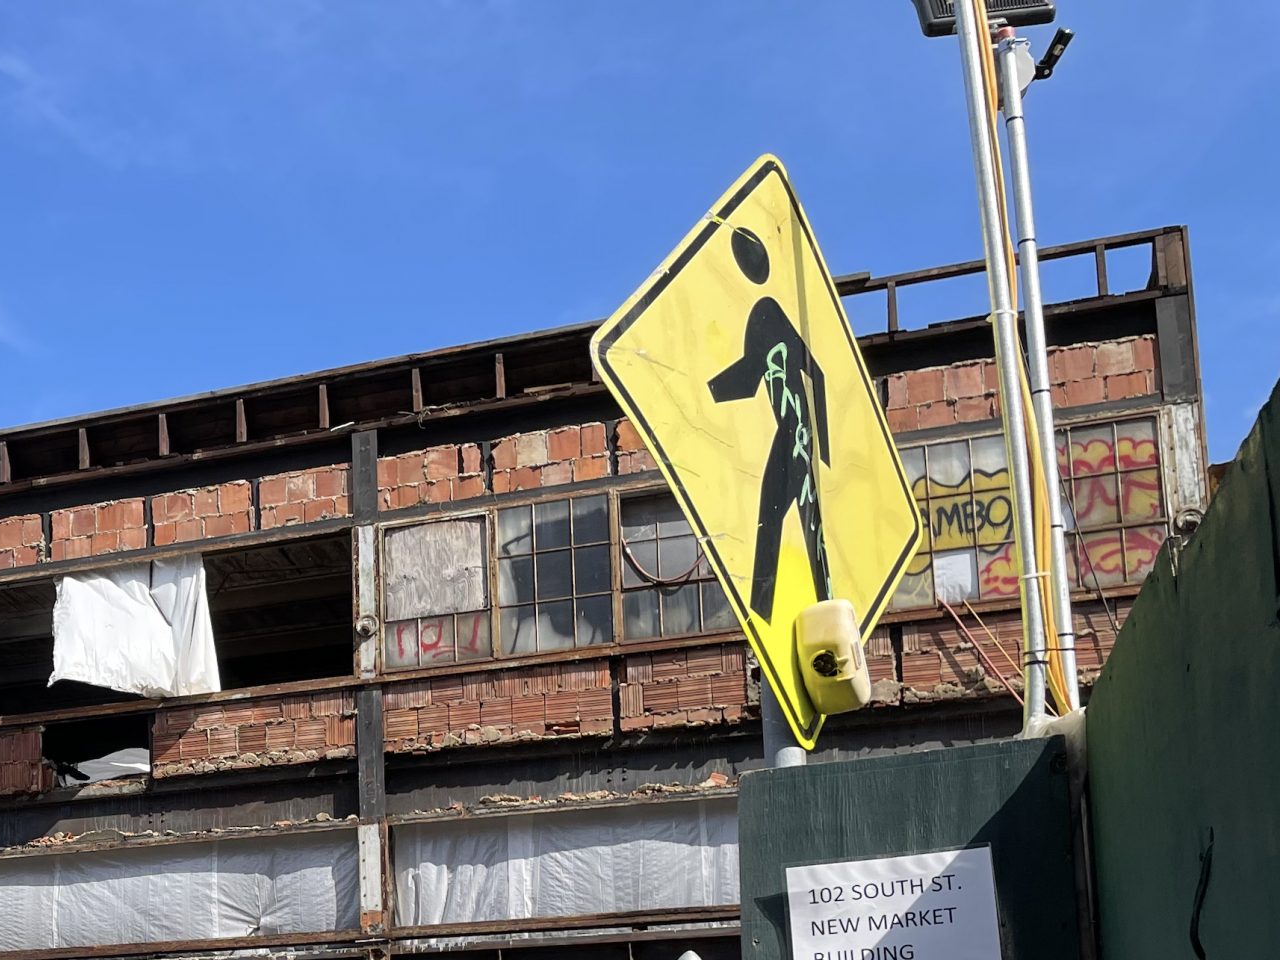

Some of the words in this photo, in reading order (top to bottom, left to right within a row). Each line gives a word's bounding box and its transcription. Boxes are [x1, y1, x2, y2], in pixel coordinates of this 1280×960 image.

[808, 886, 845, 905] 102
[851, 878, 924, 901] SOUTH
[931, 874, 963, 892] ST.
[811, 917, 860, 936] NEW
[868, 907, 958, 931] MARKET
